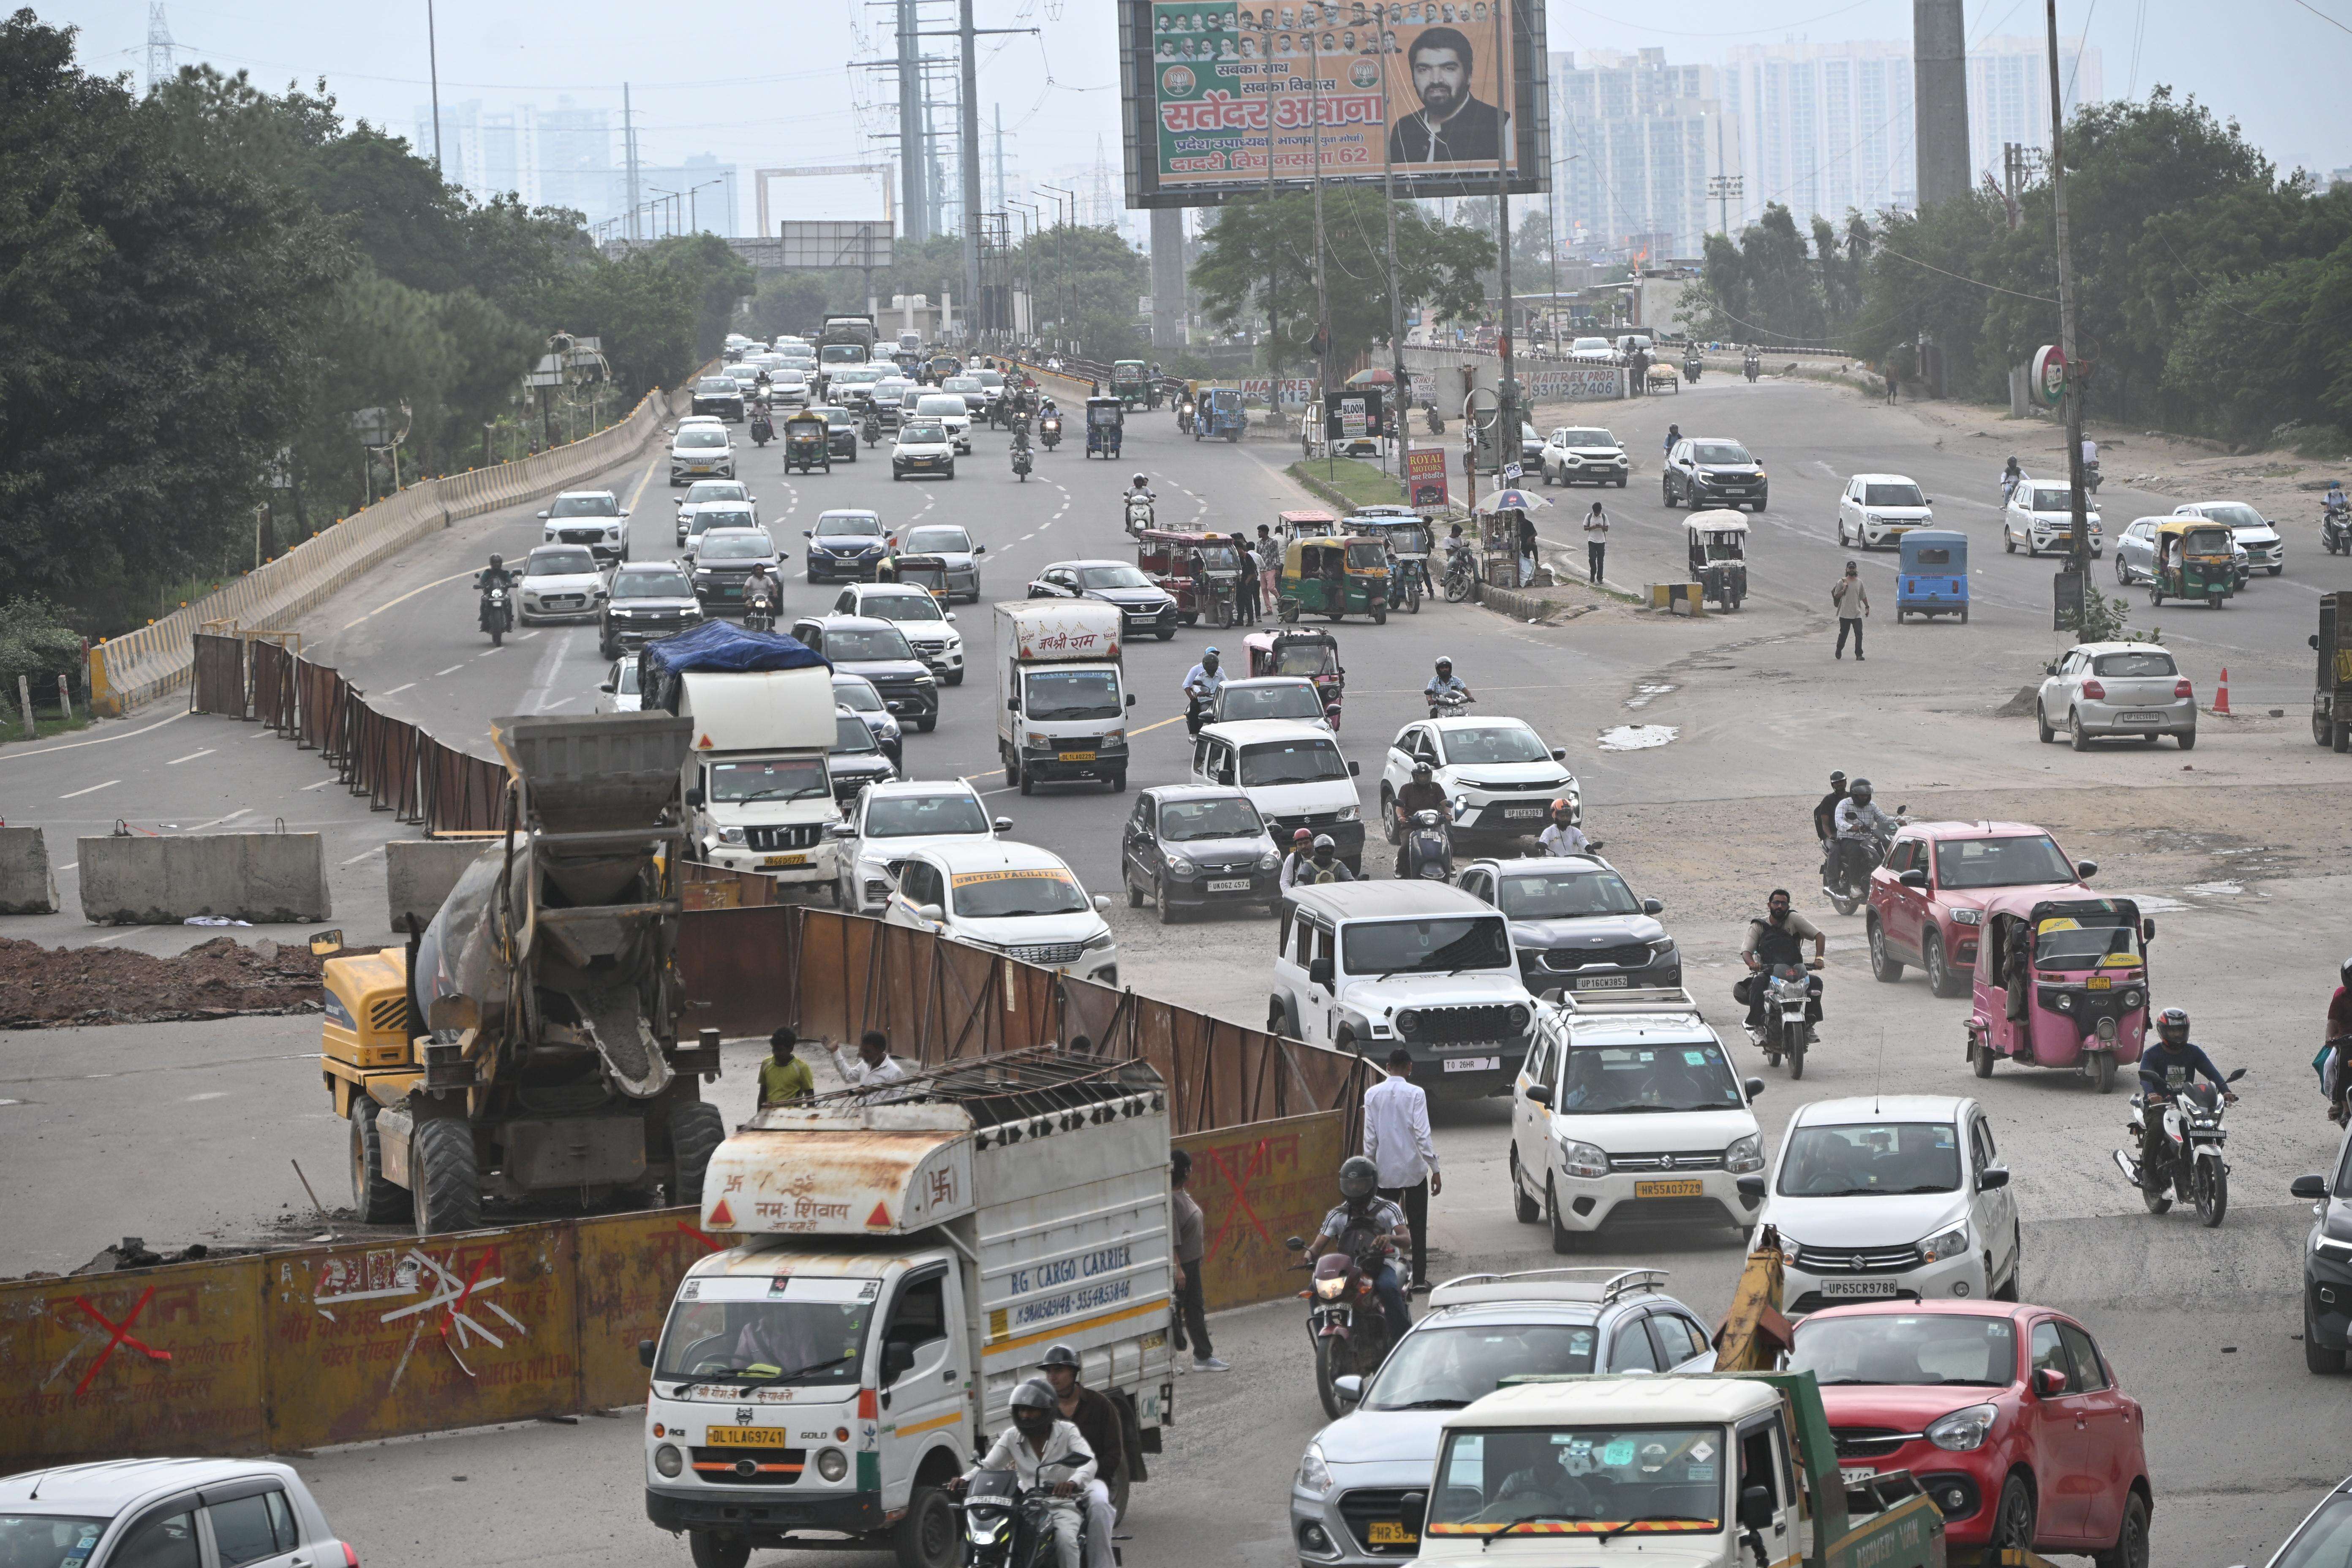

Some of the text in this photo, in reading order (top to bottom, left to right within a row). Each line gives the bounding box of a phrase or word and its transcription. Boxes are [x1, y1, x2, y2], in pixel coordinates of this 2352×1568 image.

[1216, 64, 1257, 76] सबका
[1289, 77, 1336, 92] विकास
[1170, 152, 1225, 172] दादरी
[1339, 147, 1368, 162] 62
[1587, 371, 1614, 381] PROP.
[1532, 381, 1612, 396] 9311227406
[1342, 404, 1364, 414] BLOOM
[1410, 454, 1443, 465] ROYAL
[1412, 464, 1441, 473] MOTORS
[1506, 465, 1520, 474] PG
[1069, 634, 1099, 649] राम
[956, 873, 1000, 884] UNITED
[1582, 977, 1627, 988] UP16CW3852
[1459, 1060, 1475, 1069] 26HR
[1486, 1057, 1492, 1069] 7
[754, 1196, 852, 1220] नमः शिवाय
[1011, 1246, 1132, 1296] RG CARGO CARRIER
[1829, 1280, 1895, 1294] UP65CR9788
[1076, 1280, 1130, 1311] 9354853846
[849, 1320, 859, 1330] 5
[1142, 1396, 1160, 1423] CNG
[669, 1428, 686, 1437] ACE
[713, 1430, 782, 1444] DL1LAG9741
